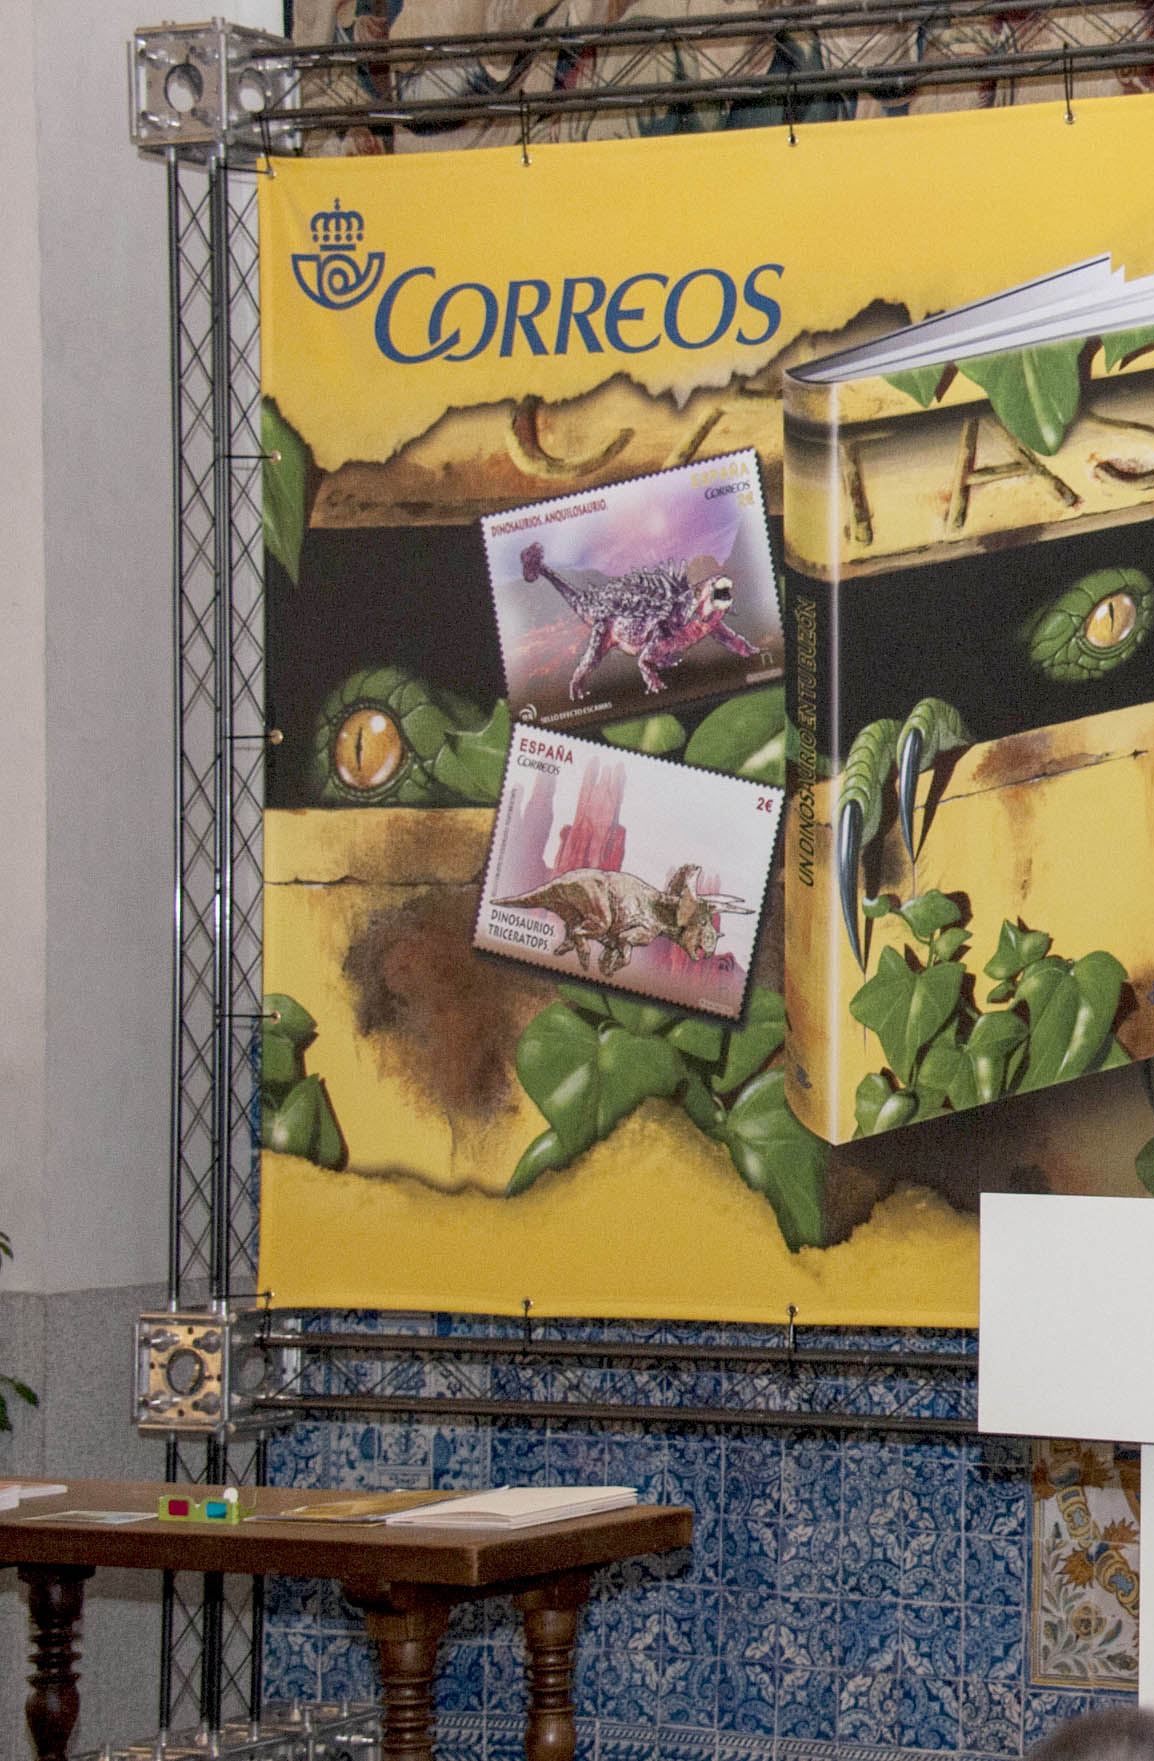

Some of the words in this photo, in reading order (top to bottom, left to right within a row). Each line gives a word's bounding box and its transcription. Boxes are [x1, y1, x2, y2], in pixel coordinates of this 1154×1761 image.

[374, 262, 786, 365] CORREOS
[690, 462, 750, 489] ESPAÑA
[704, 480, 751, 500] CORREOS
[517, 754, 561, 776] CORREOS
[520, 738, 574, 765] ESPAÑA
[756, 796, 774, 813] 2€
[798, 855, 815, 887] UN
